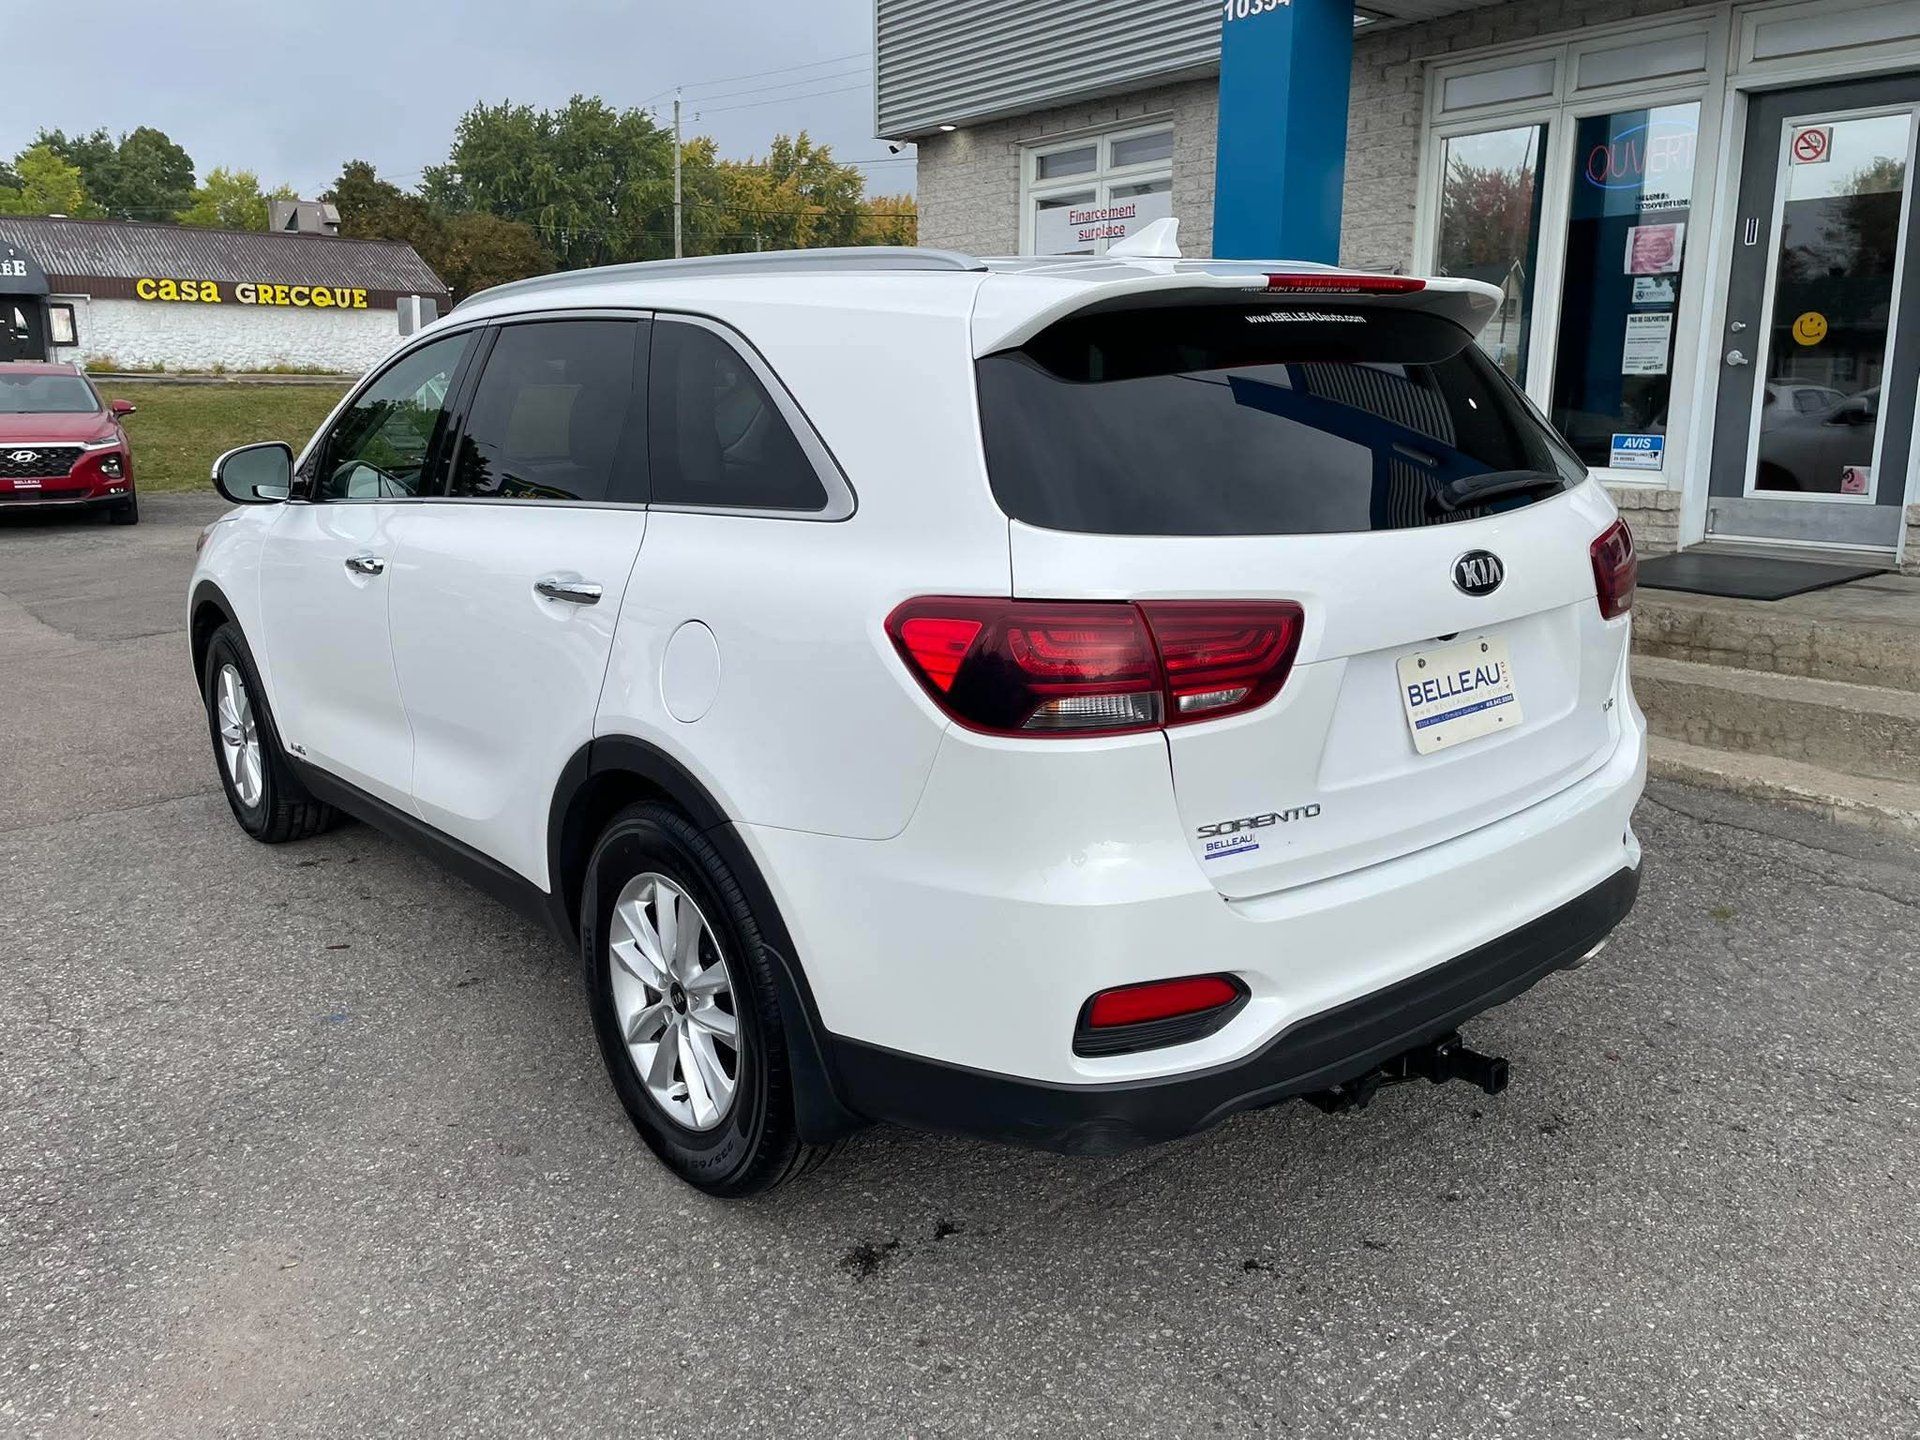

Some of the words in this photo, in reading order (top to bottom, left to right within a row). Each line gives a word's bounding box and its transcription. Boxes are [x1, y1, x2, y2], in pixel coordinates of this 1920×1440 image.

[1224, 0, 1290, 21] 103
[1588, 132, 1695, 181] OUVERT
[0, 260, 27, 276] ÉE
[235, 282, 368, 308] GRECQUE
[1622, 437, 1652, 449] AVIS
[1460, 557, 1501, 587] KIA
[1407, 662, 1501, 707] BELLEAU
[1197, 803, 1321, 839] SORENTO
[1206, 834, 1254, 852] BELLEAU
